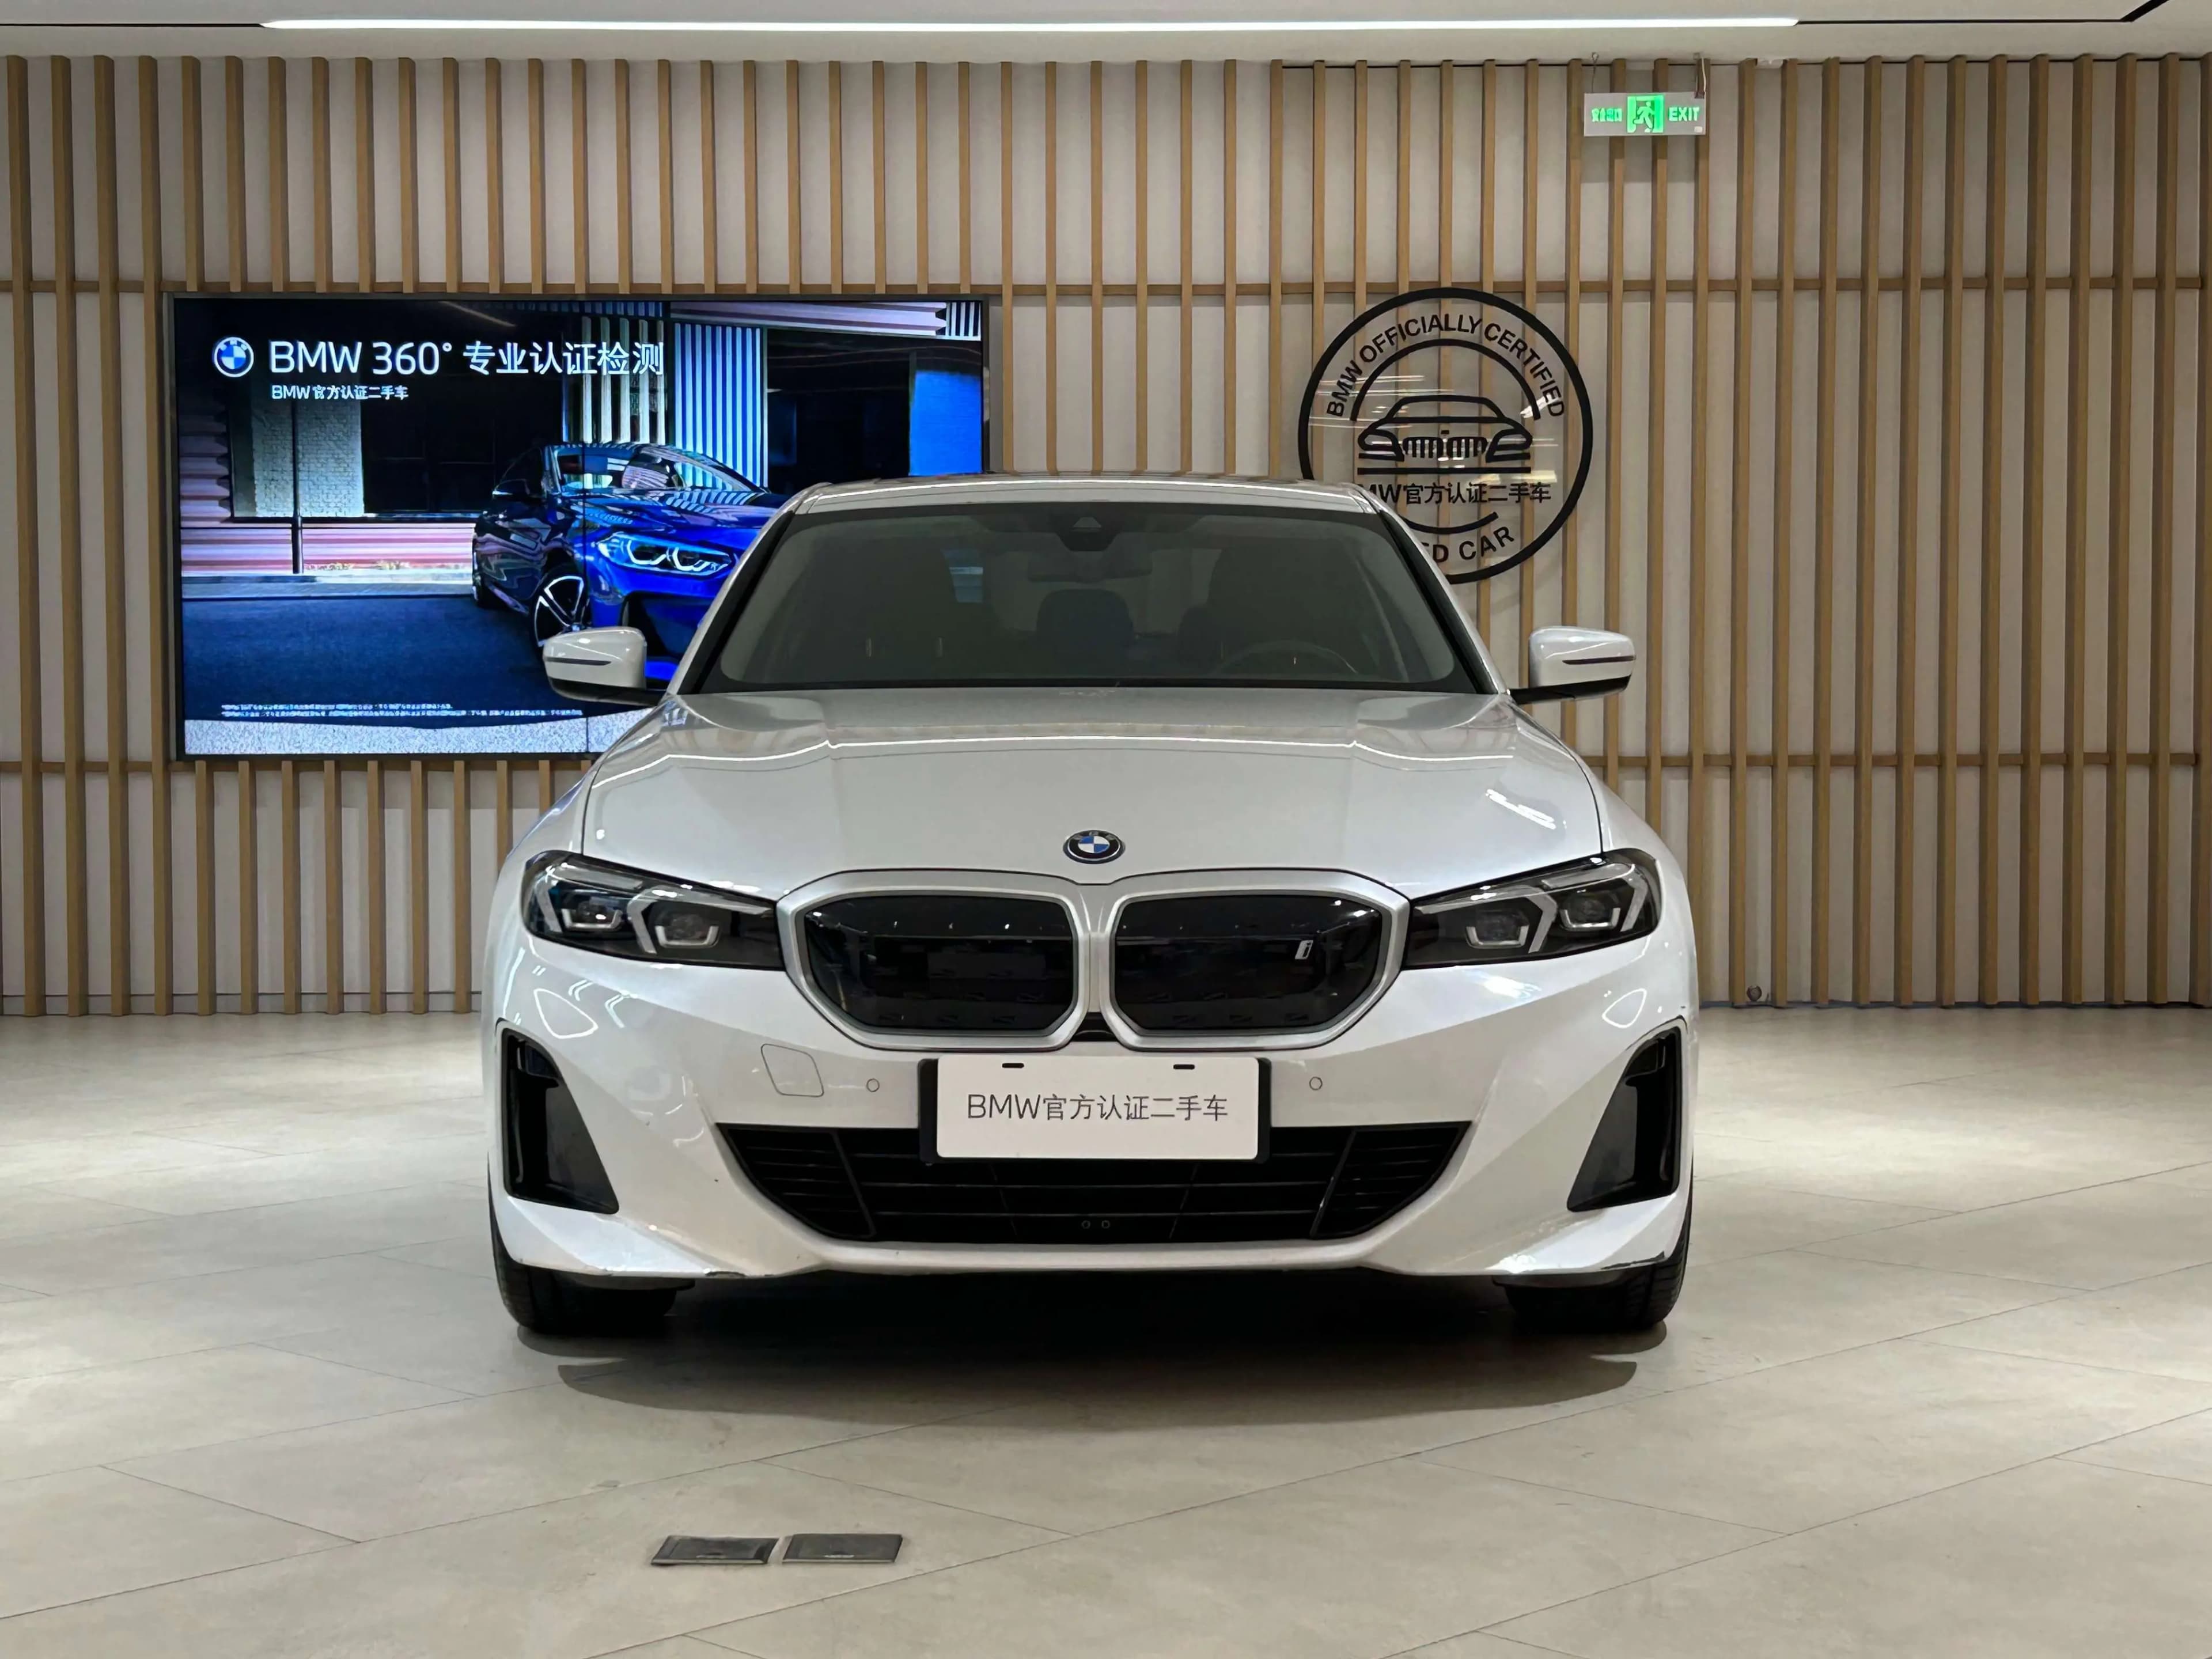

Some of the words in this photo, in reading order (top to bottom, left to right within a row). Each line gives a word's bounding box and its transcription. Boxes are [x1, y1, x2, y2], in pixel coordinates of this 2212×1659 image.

[1669, 107, 1700, 122] EXIT
[270, 341, 362, 373] BMW
[373, 342, 452, 375] 360°
[463, 340, 664, 375] 专业认证检测
[1327, 359, 1363, 416] BMW
[1359, 313, 1482, 362] OFFICIALLY
[1484, 323, 1565, 416] CERTIFIED
[1459, 527, 1514, 560] CAR
